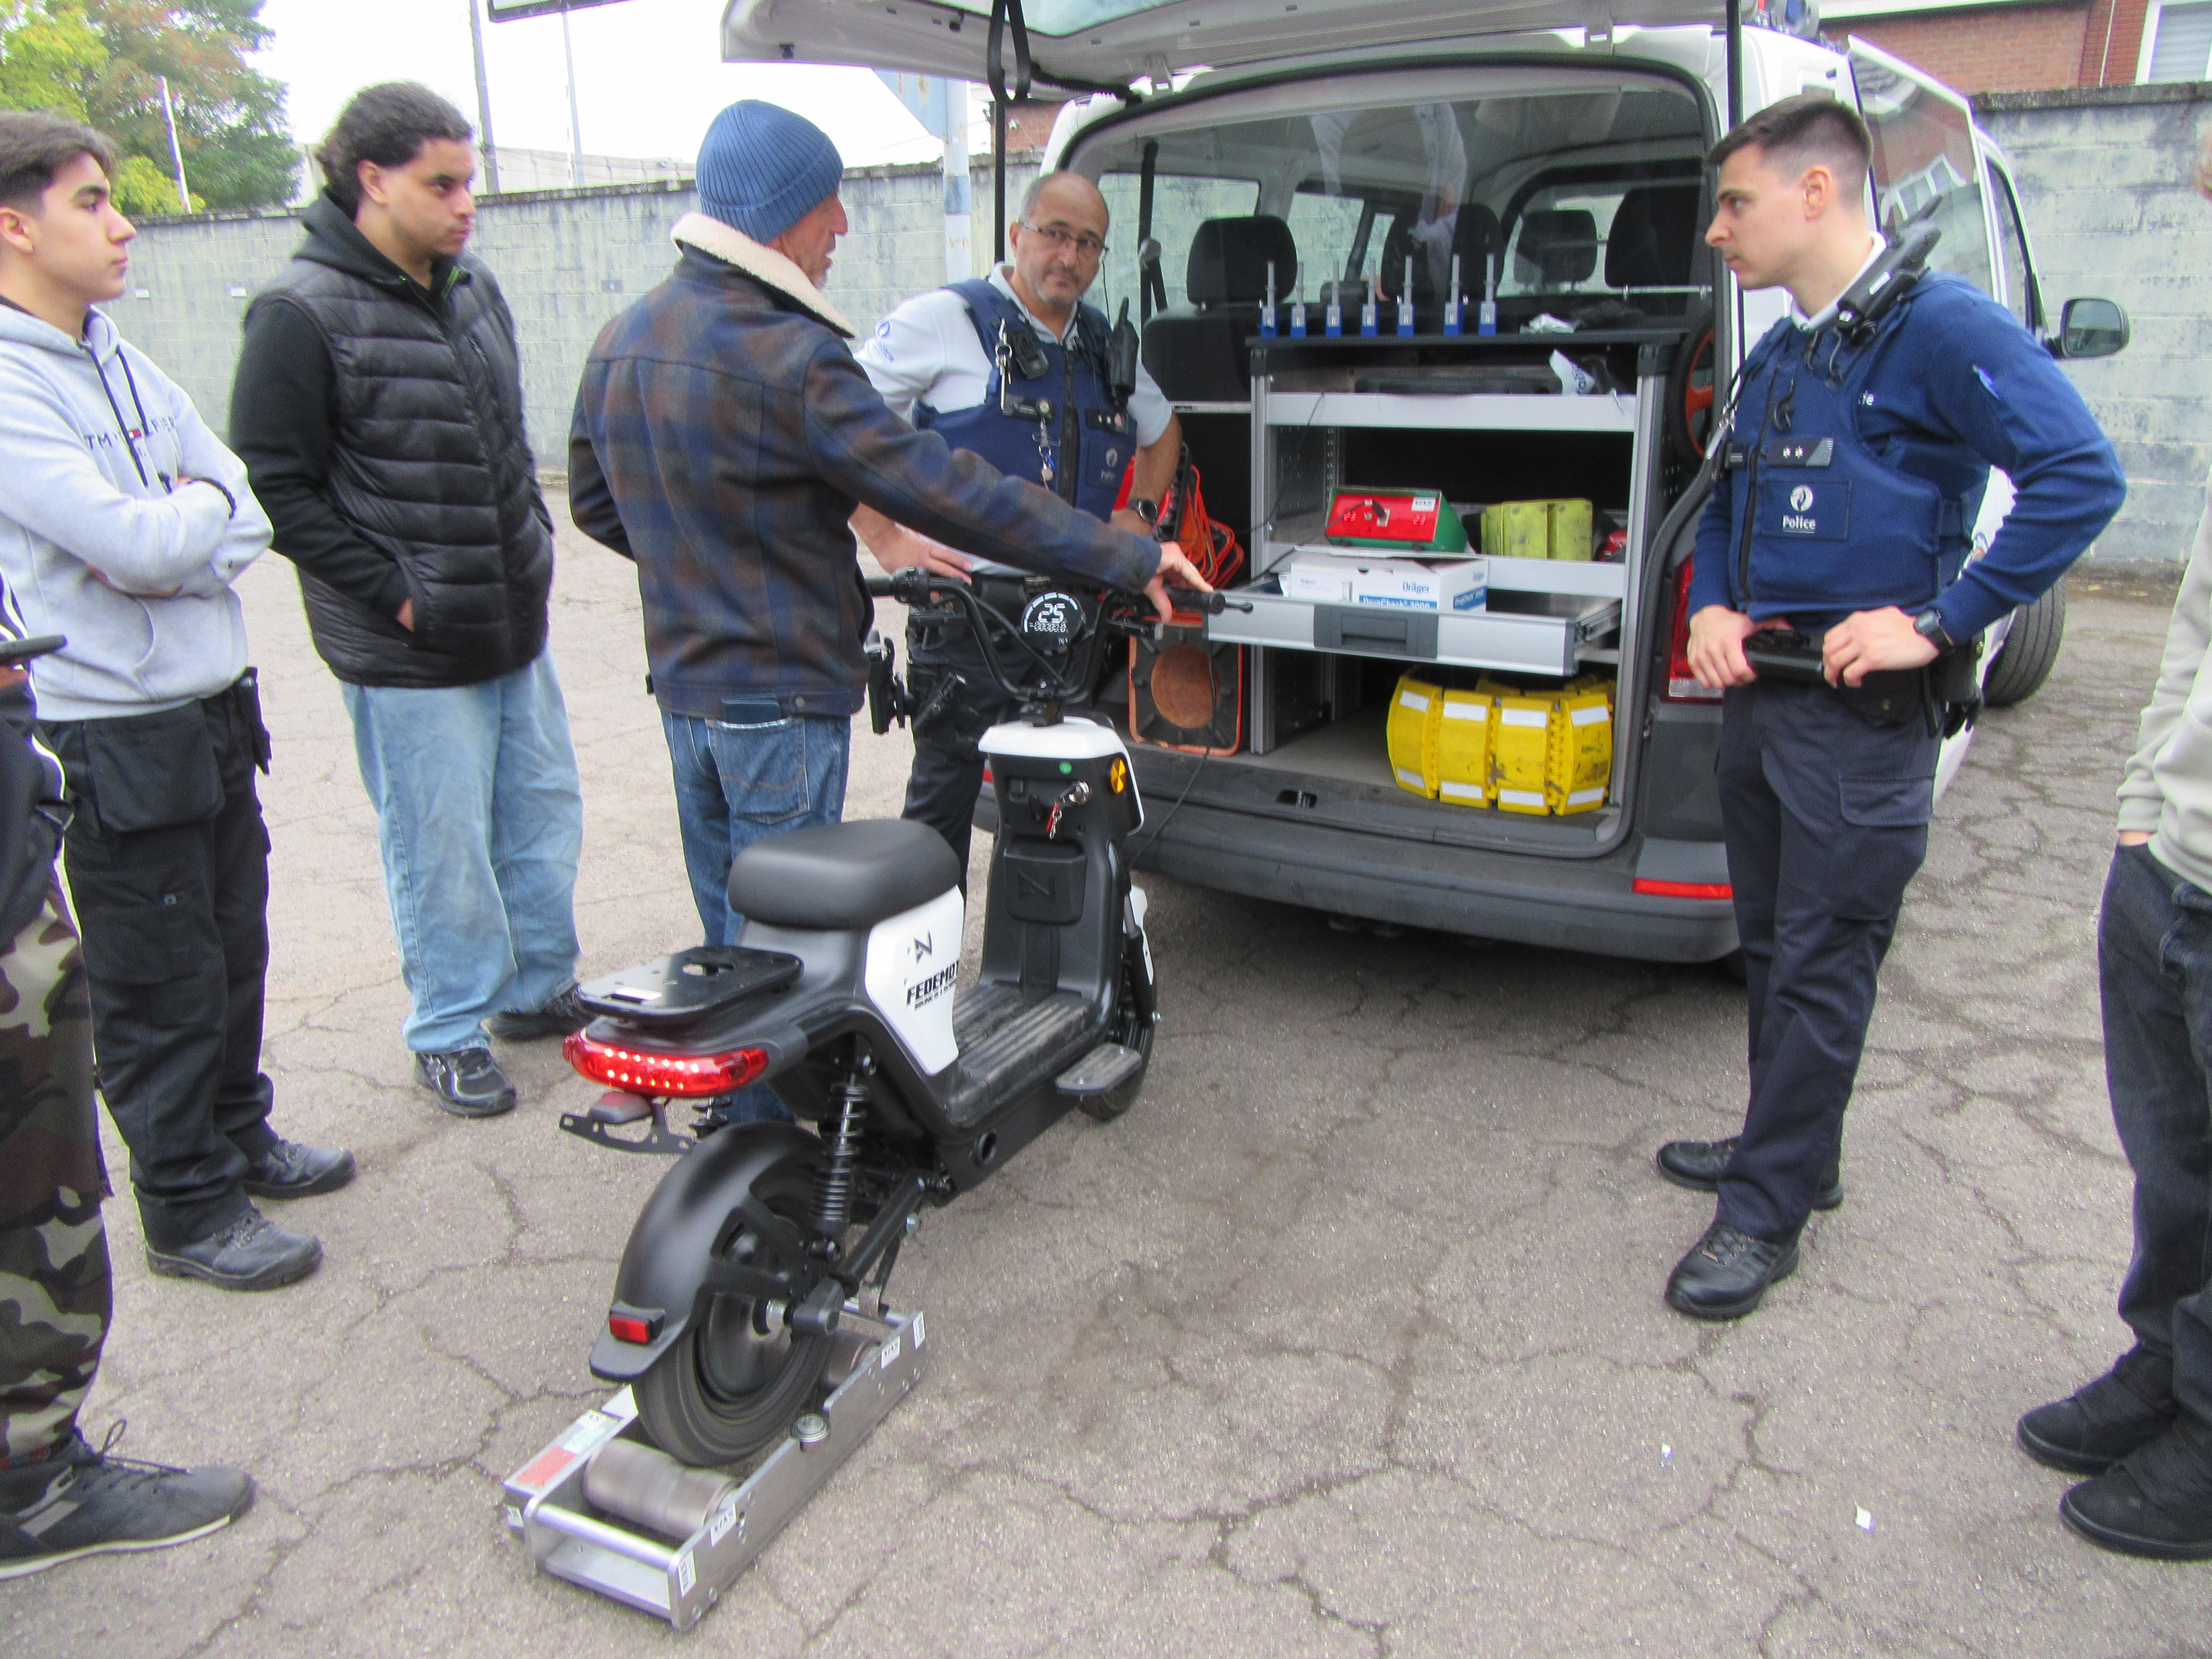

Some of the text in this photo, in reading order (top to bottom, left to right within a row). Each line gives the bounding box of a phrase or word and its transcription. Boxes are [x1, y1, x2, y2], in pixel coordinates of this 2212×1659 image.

[1783, 515, 1816, 529] Police
[1403, 581, 1430, 595] Dräger
[1038, 603, 1066, 623] 25
